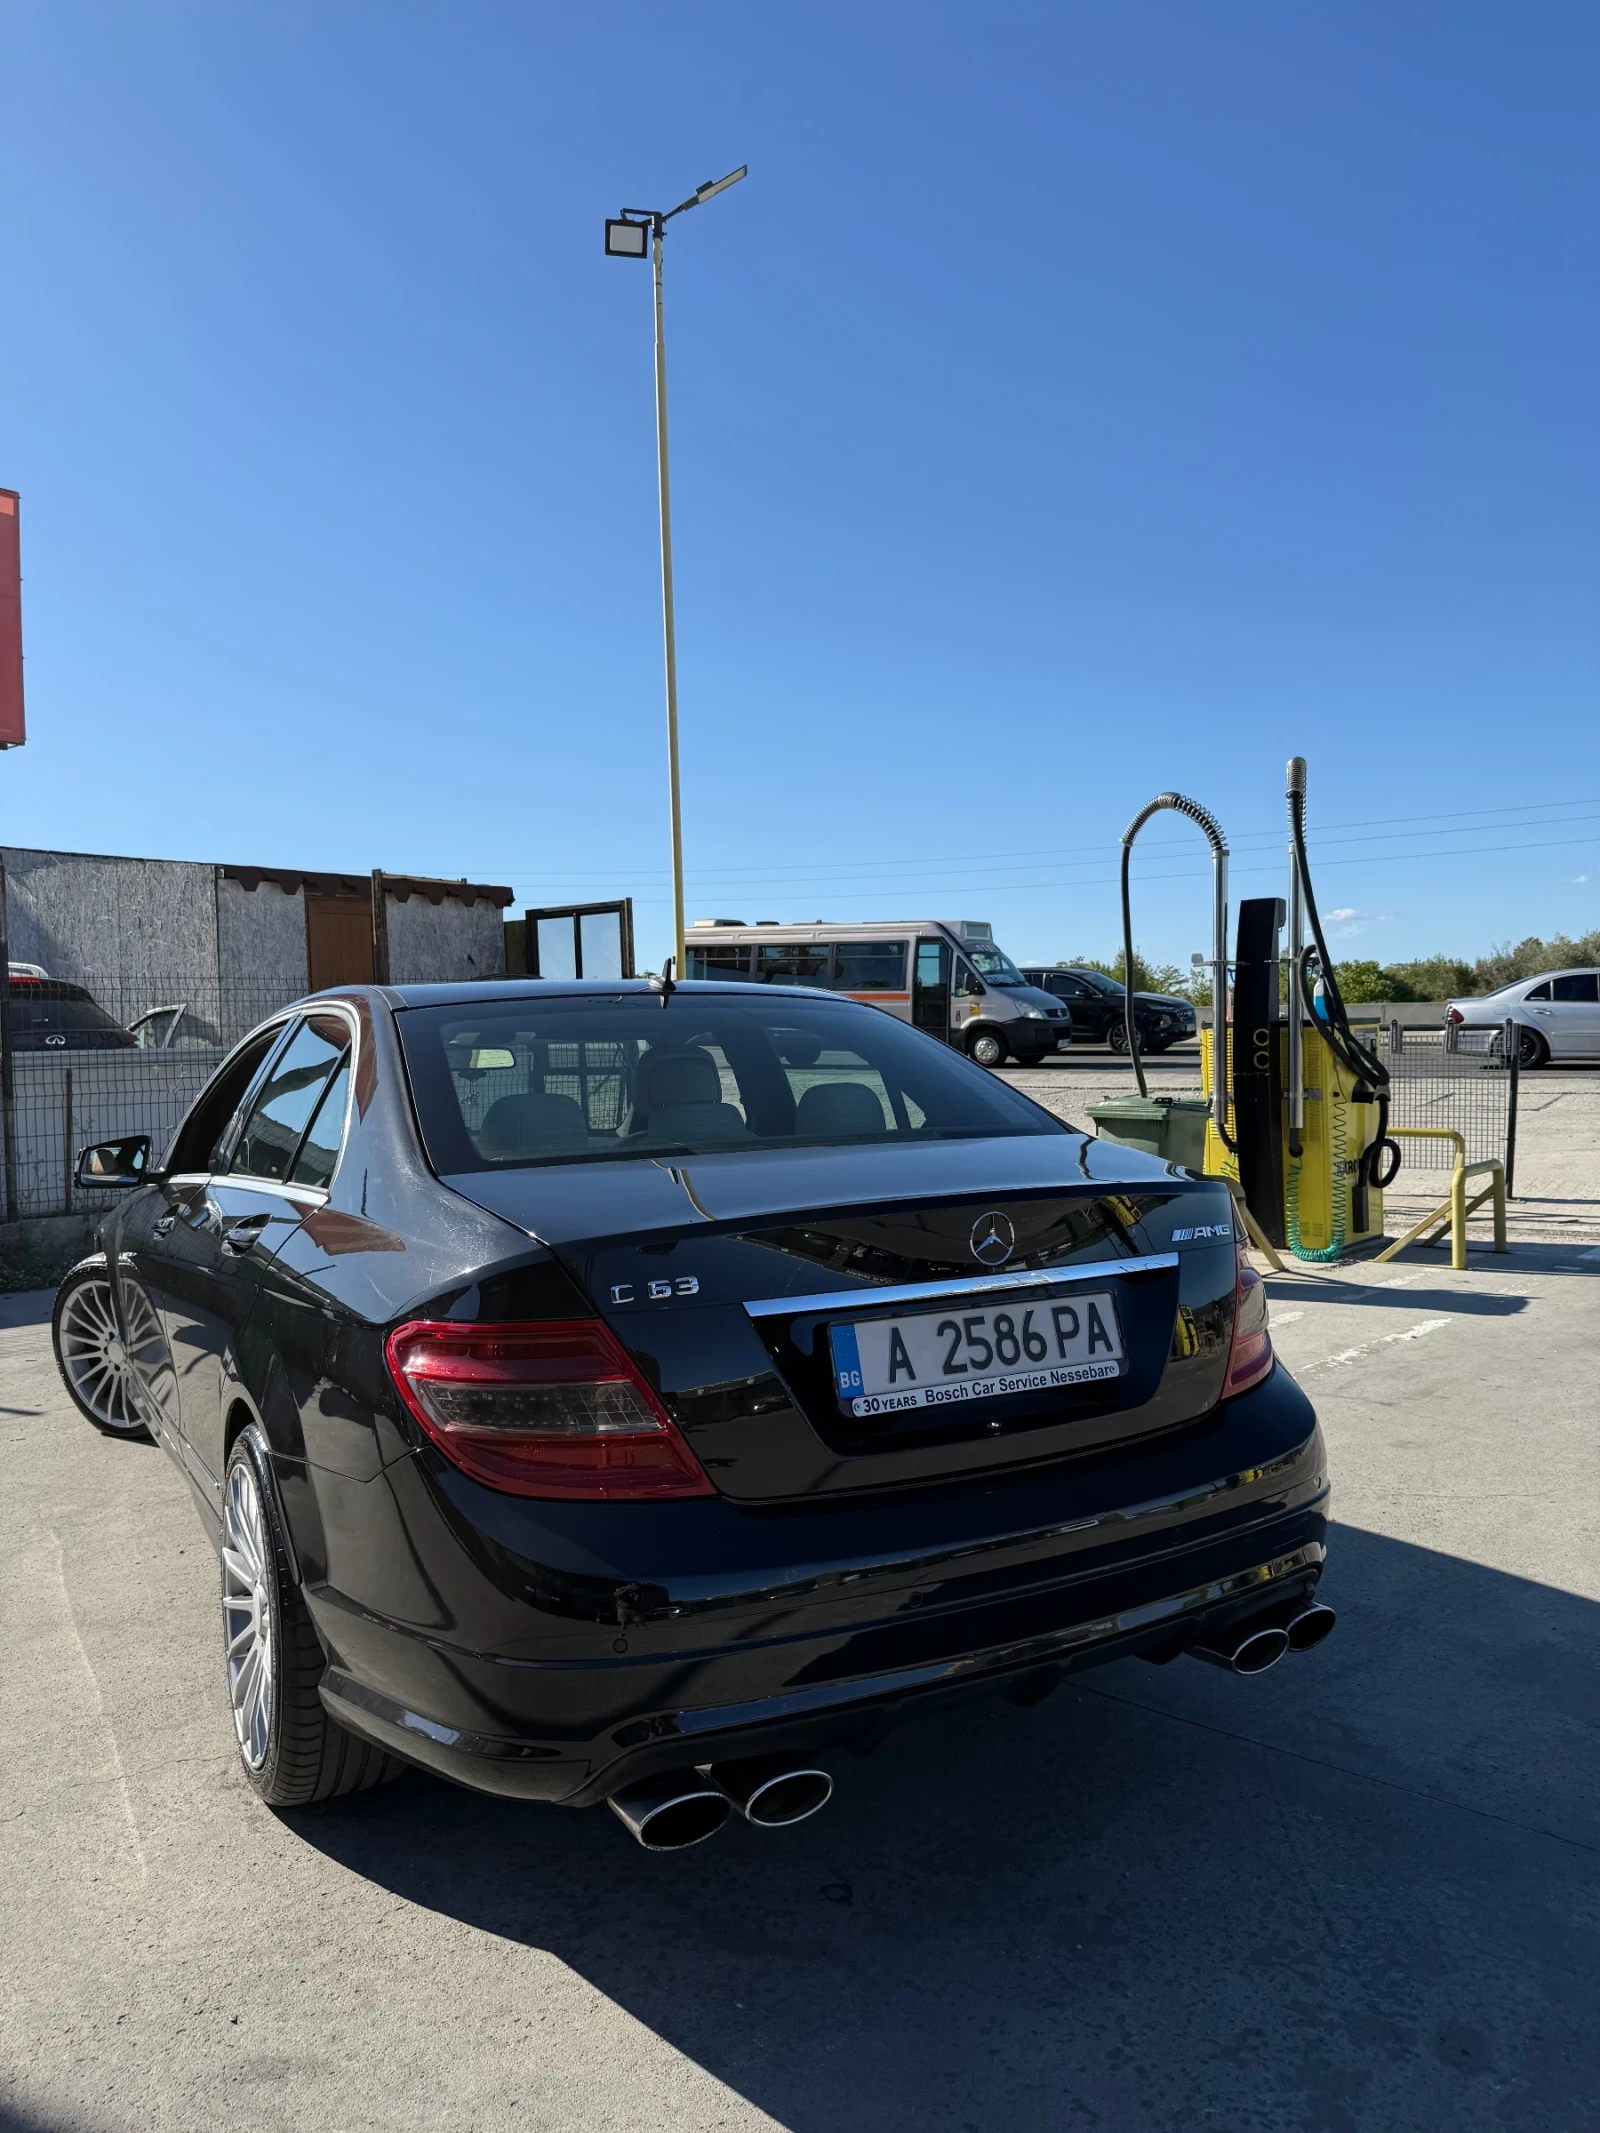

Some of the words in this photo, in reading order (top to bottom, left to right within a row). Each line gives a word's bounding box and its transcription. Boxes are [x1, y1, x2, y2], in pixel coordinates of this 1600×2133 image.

[1193, 1224, 1231, 1239] AMG
[610, 1284, 635, 1304] C
[647, 1275, 700, 1299] 63
[889, 1327, 917, 1384] A
[839, 1371, 861, 1389] BG
[862, 1398, 881, 1414] 30
[881, 1395, 917, 1411] YEARS
[924, 1384, 969, 1405] Bosch
[972, 1380, 996, 1396] Car
[998, 1374, 1047, 1392] Service
[1050, 1364, 1109, 1384] Nessebar
